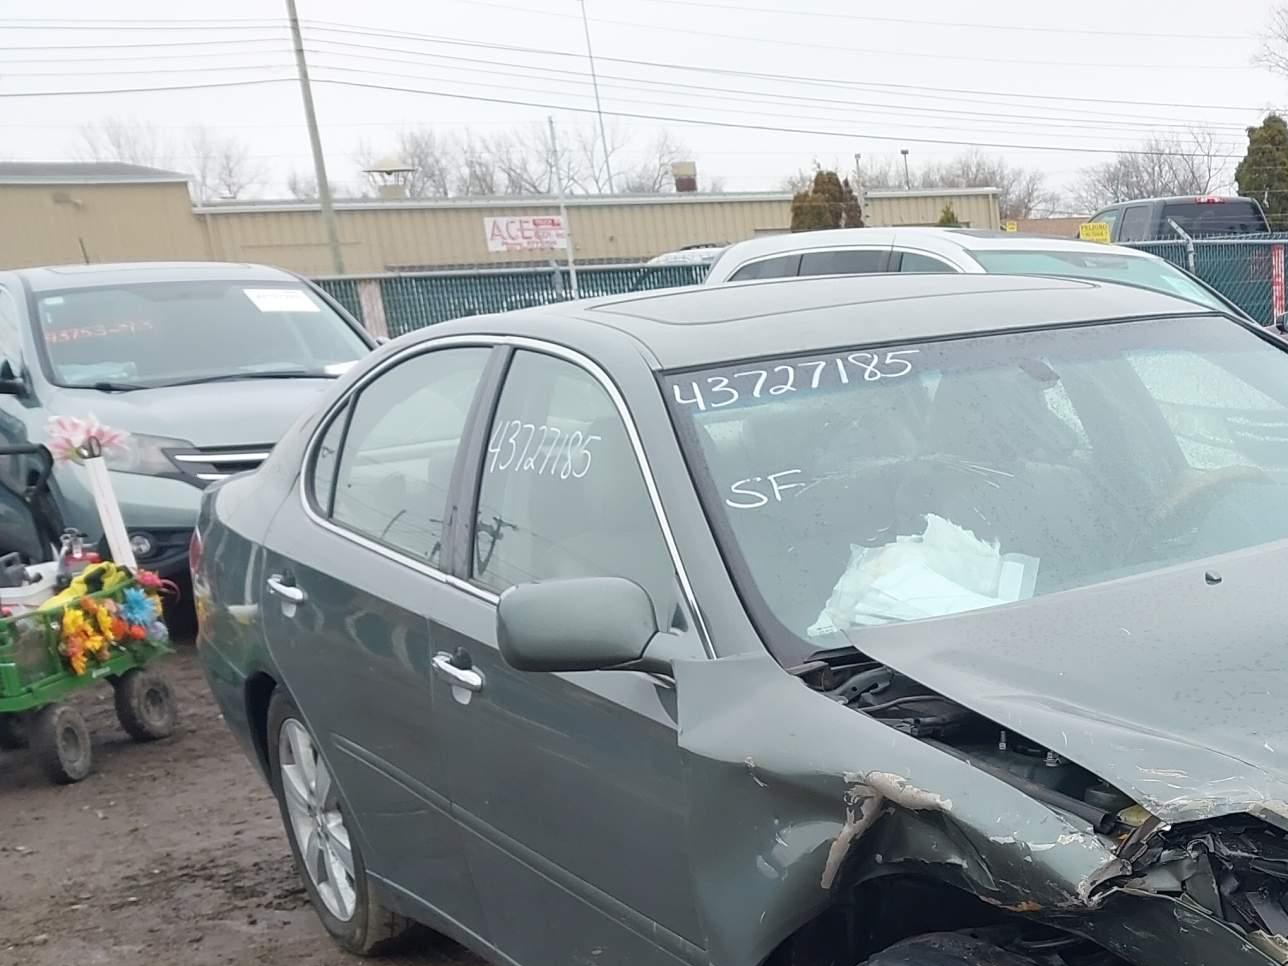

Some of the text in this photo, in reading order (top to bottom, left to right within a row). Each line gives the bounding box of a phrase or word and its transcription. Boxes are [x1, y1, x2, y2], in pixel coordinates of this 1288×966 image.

[489, 220, 533, 241] ACE
[672, 350, 920, 410] 43727185
[488, 420, 602, 479] 43727185
[726, 469, 806, 508] SF
